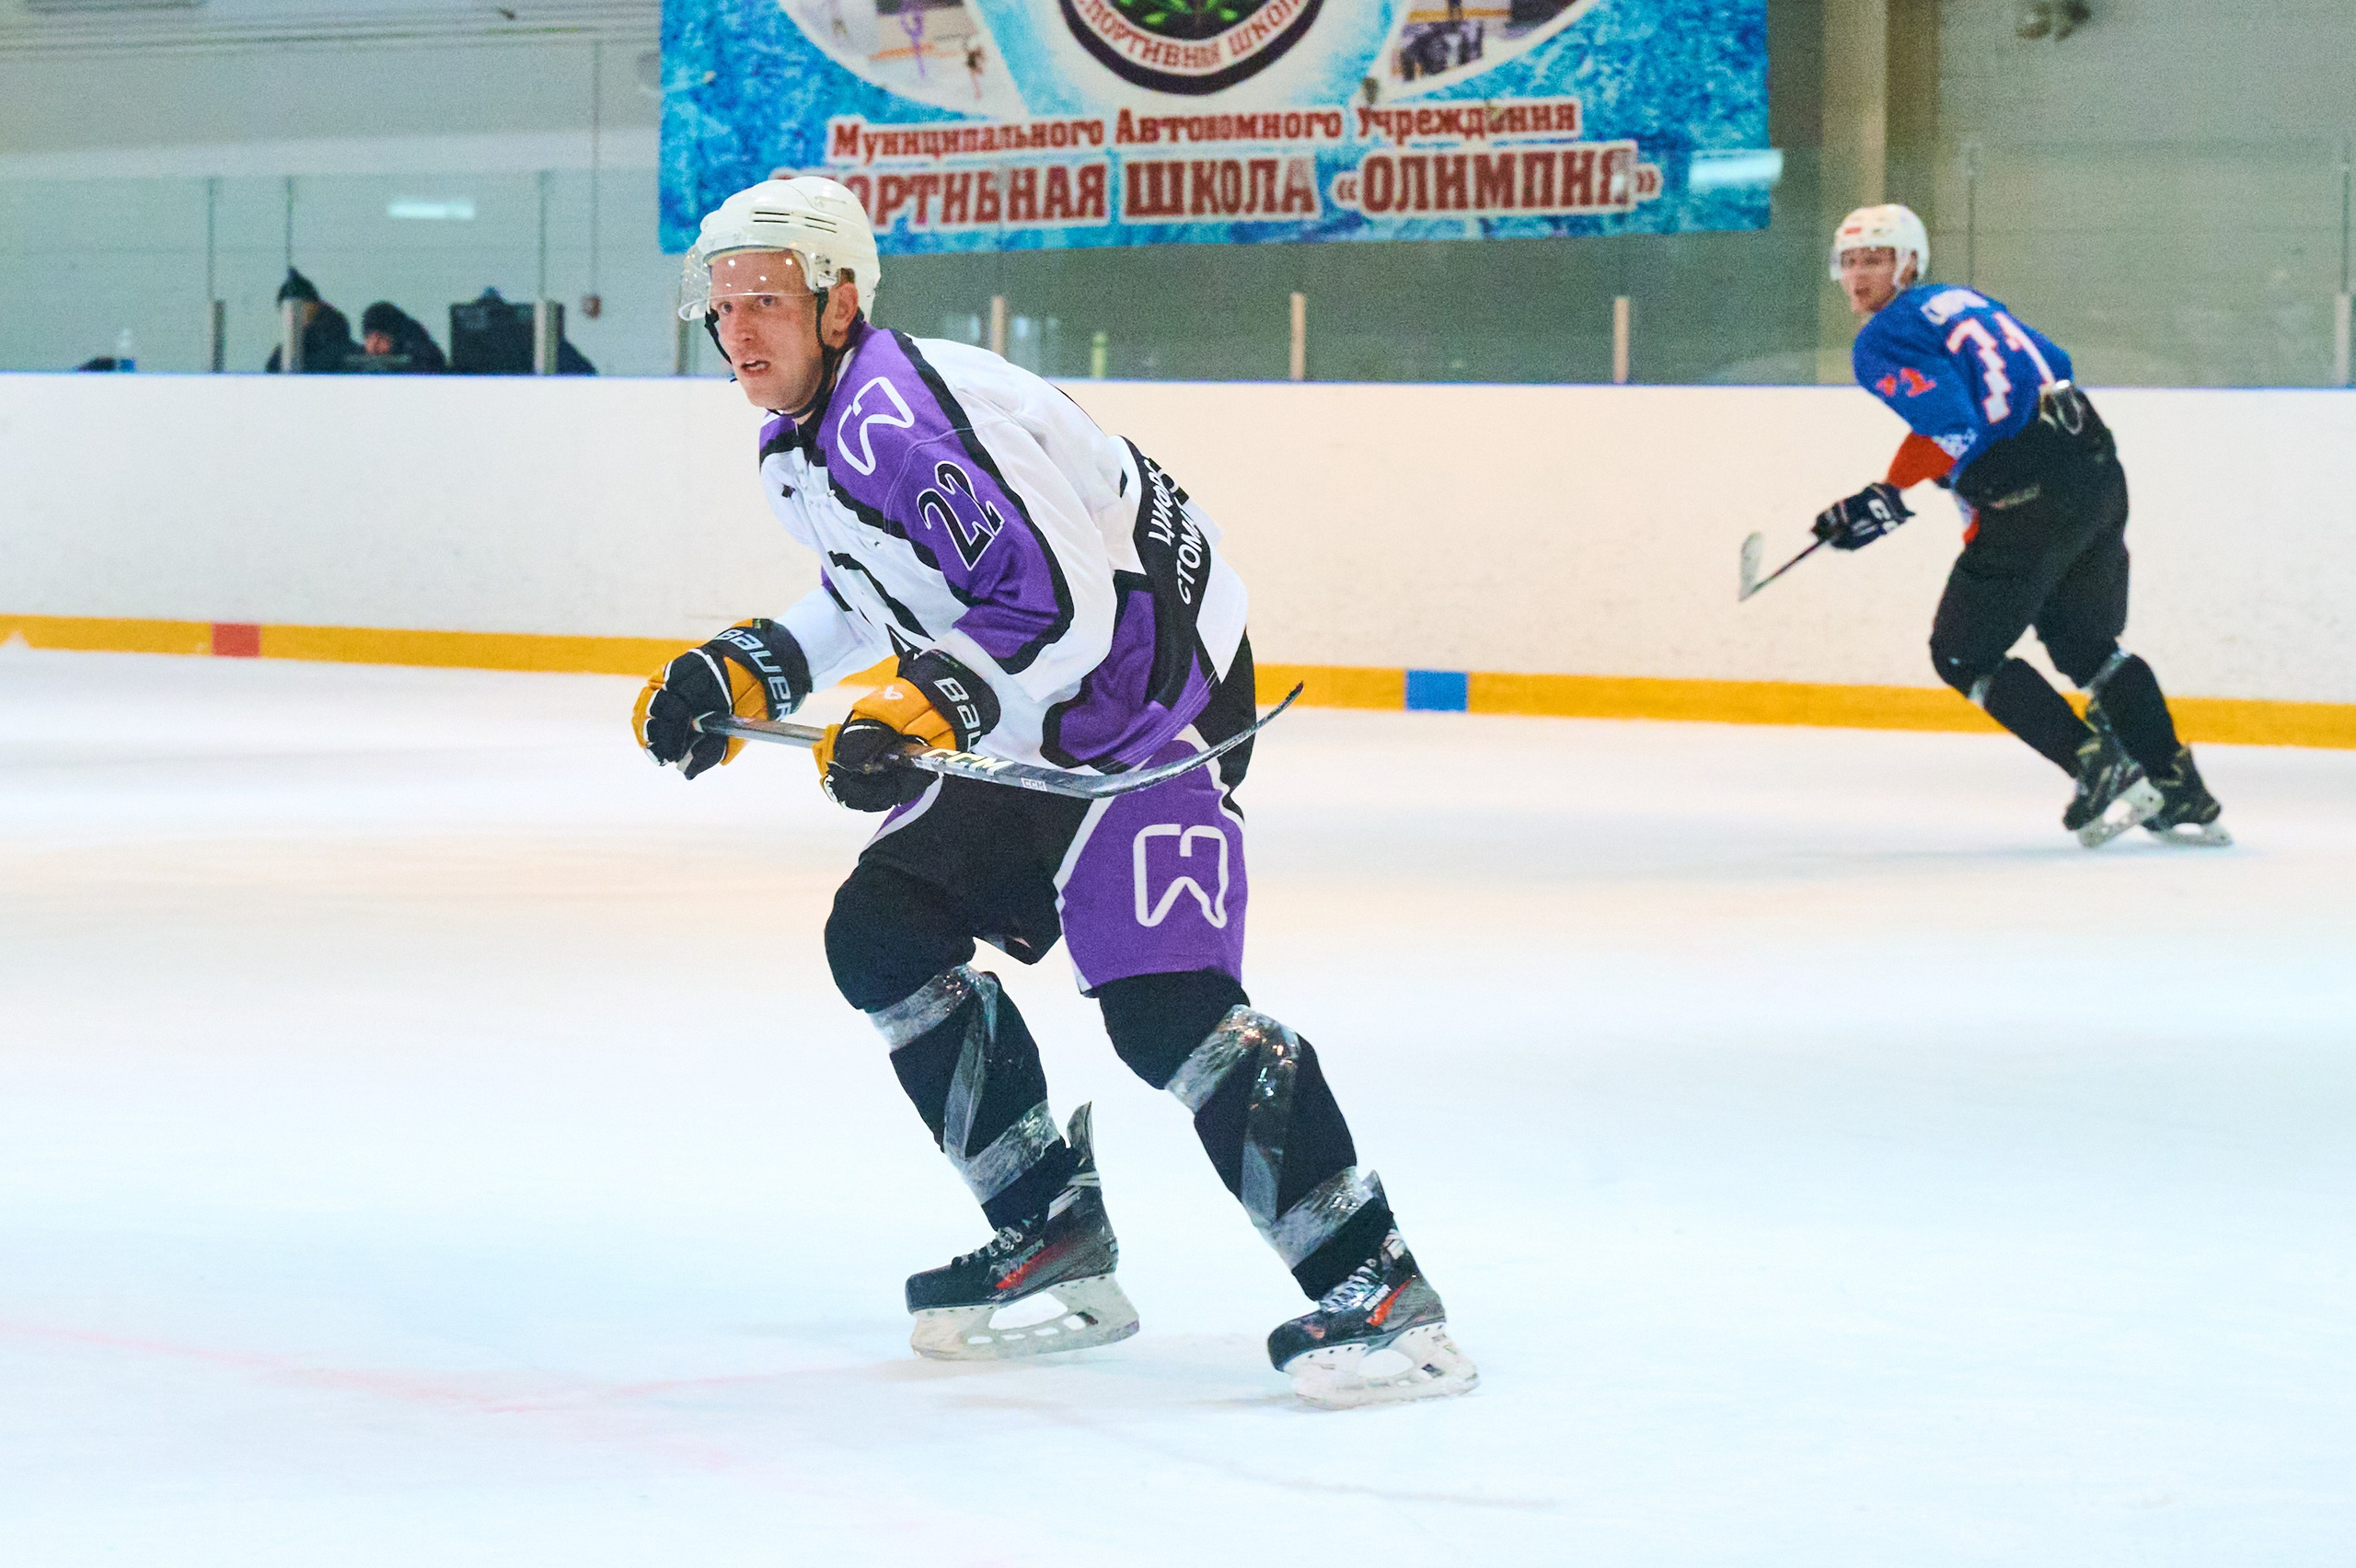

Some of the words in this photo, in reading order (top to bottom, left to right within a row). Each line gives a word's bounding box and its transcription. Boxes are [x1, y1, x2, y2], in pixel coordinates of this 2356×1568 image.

[1079, 0, 1222, 67] ПОРТИВНАЯ
[833, 120, 1103, 165] Муниципального
[1115, 109, 1342, 144] Автономного
[1357, 103, 1576, 145] Учреждения
[776, 163, 1106, 225] ОРТИВНАЯ
[1125, 158, 1315, 216] ШКОЛА
[917, 461, 1005, 571] 22
[1022, 778, 1046, 790] CCM
